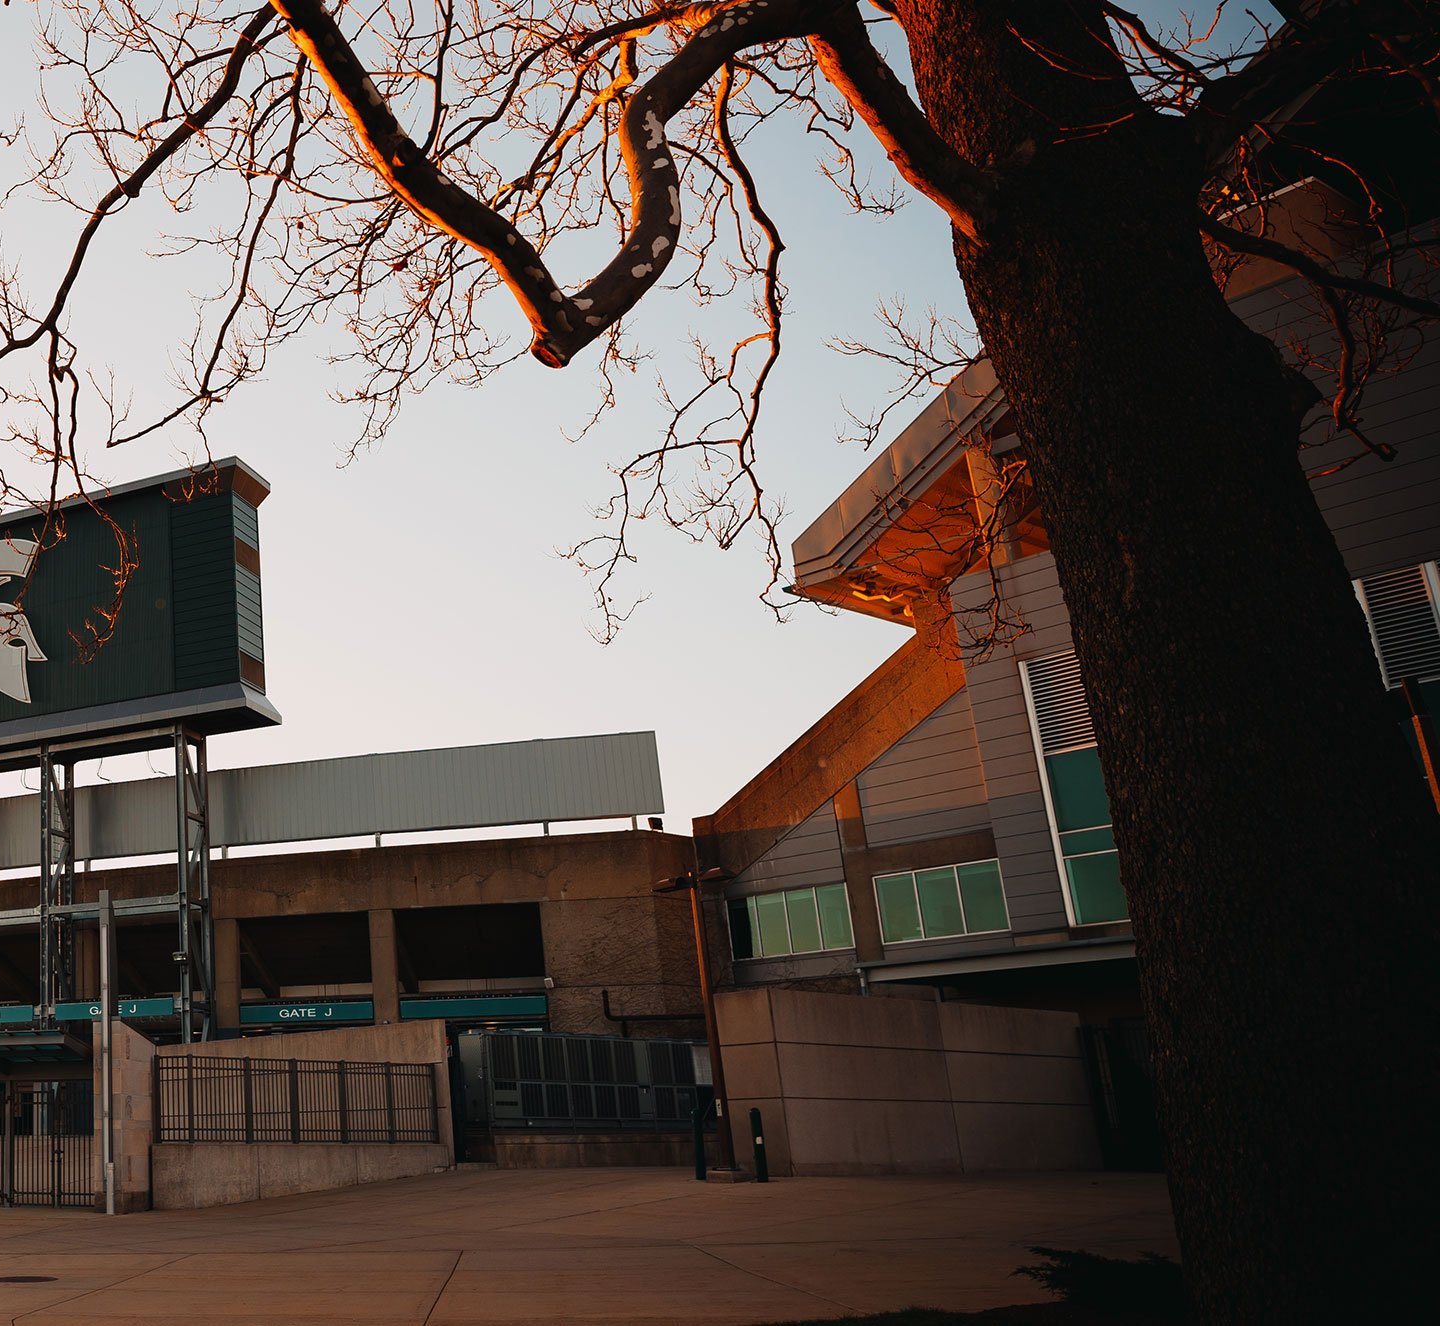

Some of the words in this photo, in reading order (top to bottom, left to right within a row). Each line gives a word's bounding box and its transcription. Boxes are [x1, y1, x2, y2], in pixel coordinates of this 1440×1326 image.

[89, 1004, 122, 1015] GE
[129, 1004, 137, 1014] J
[279, 1008, 316, 1018] GATE
[324, 1008, 332, 1017] J
